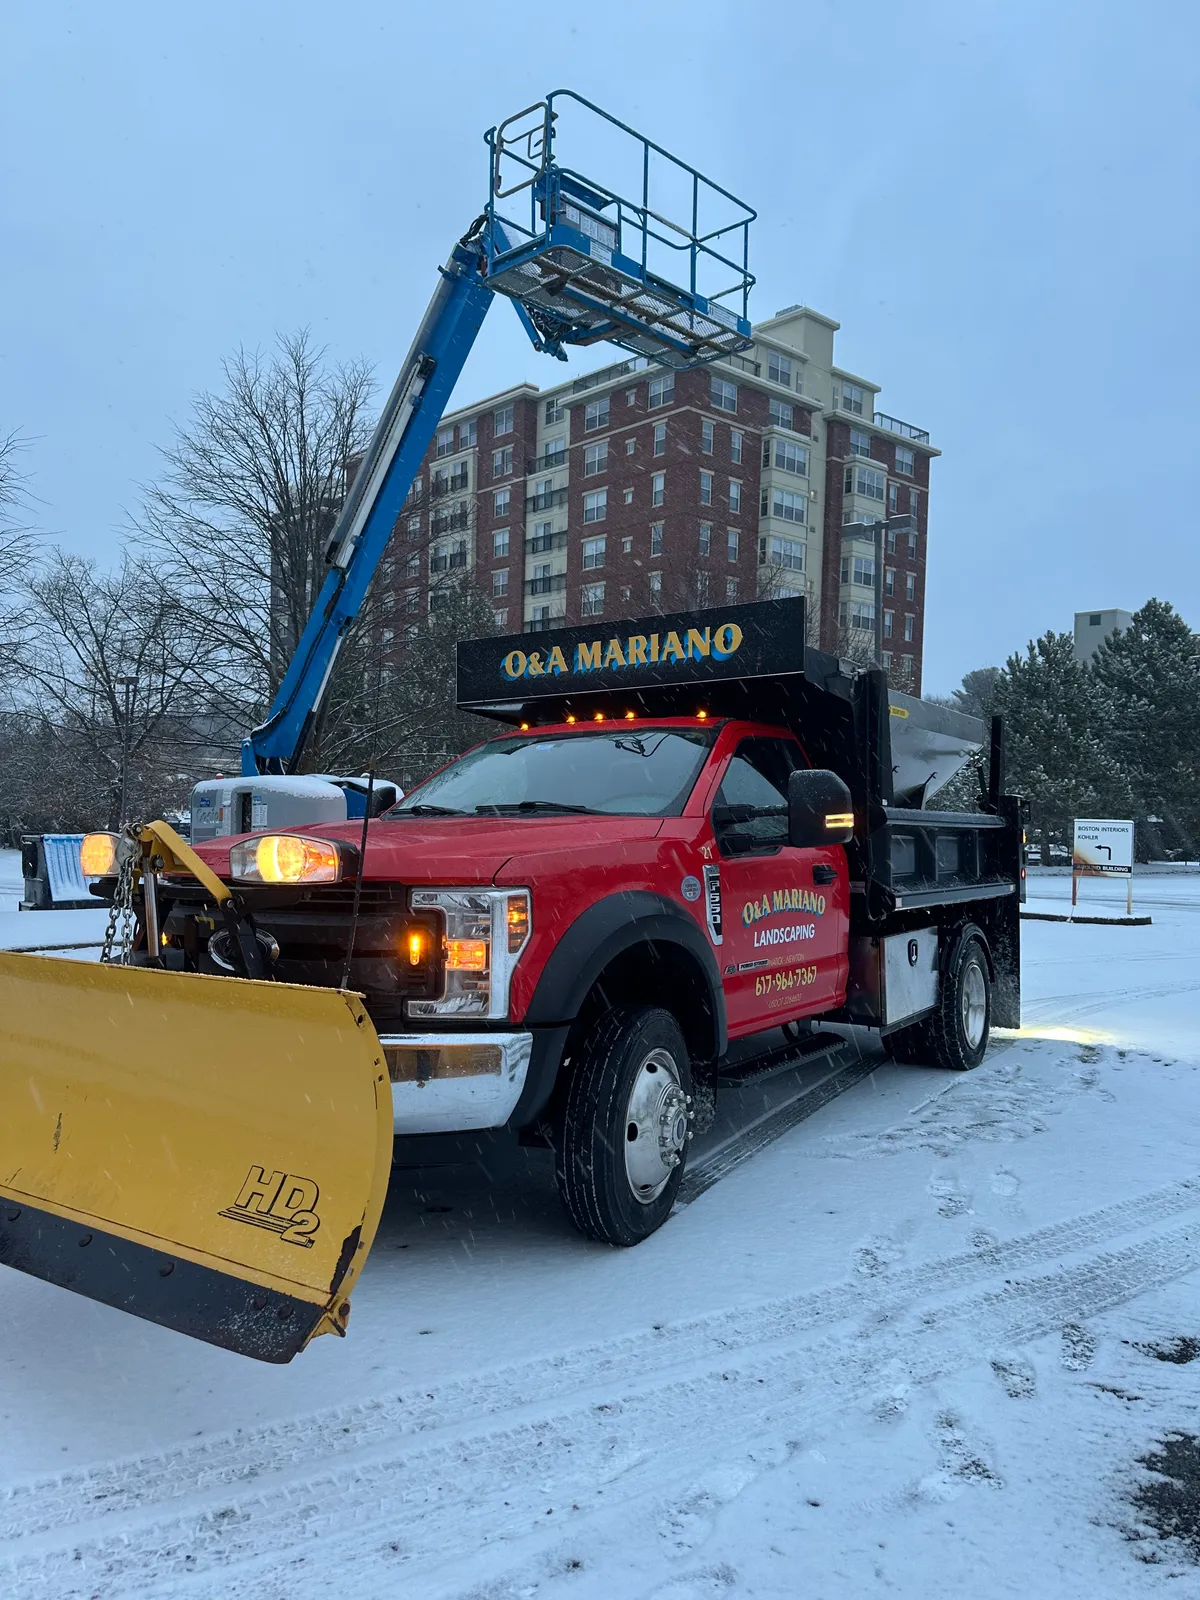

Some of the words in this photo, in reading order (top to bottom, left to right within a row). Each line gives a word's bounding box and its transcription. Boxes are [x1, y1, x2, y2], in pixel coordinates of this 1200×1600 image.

[501, 645, 568, 681] O&A
[574, 623, 743, 674] MARIANO
[701, 846, 713, 859] 21
[742, 894, 771, 926] O&A
[773, 888, 826, 917] MARIANO
[754, 923, 815, 948] LANDSCAPING
